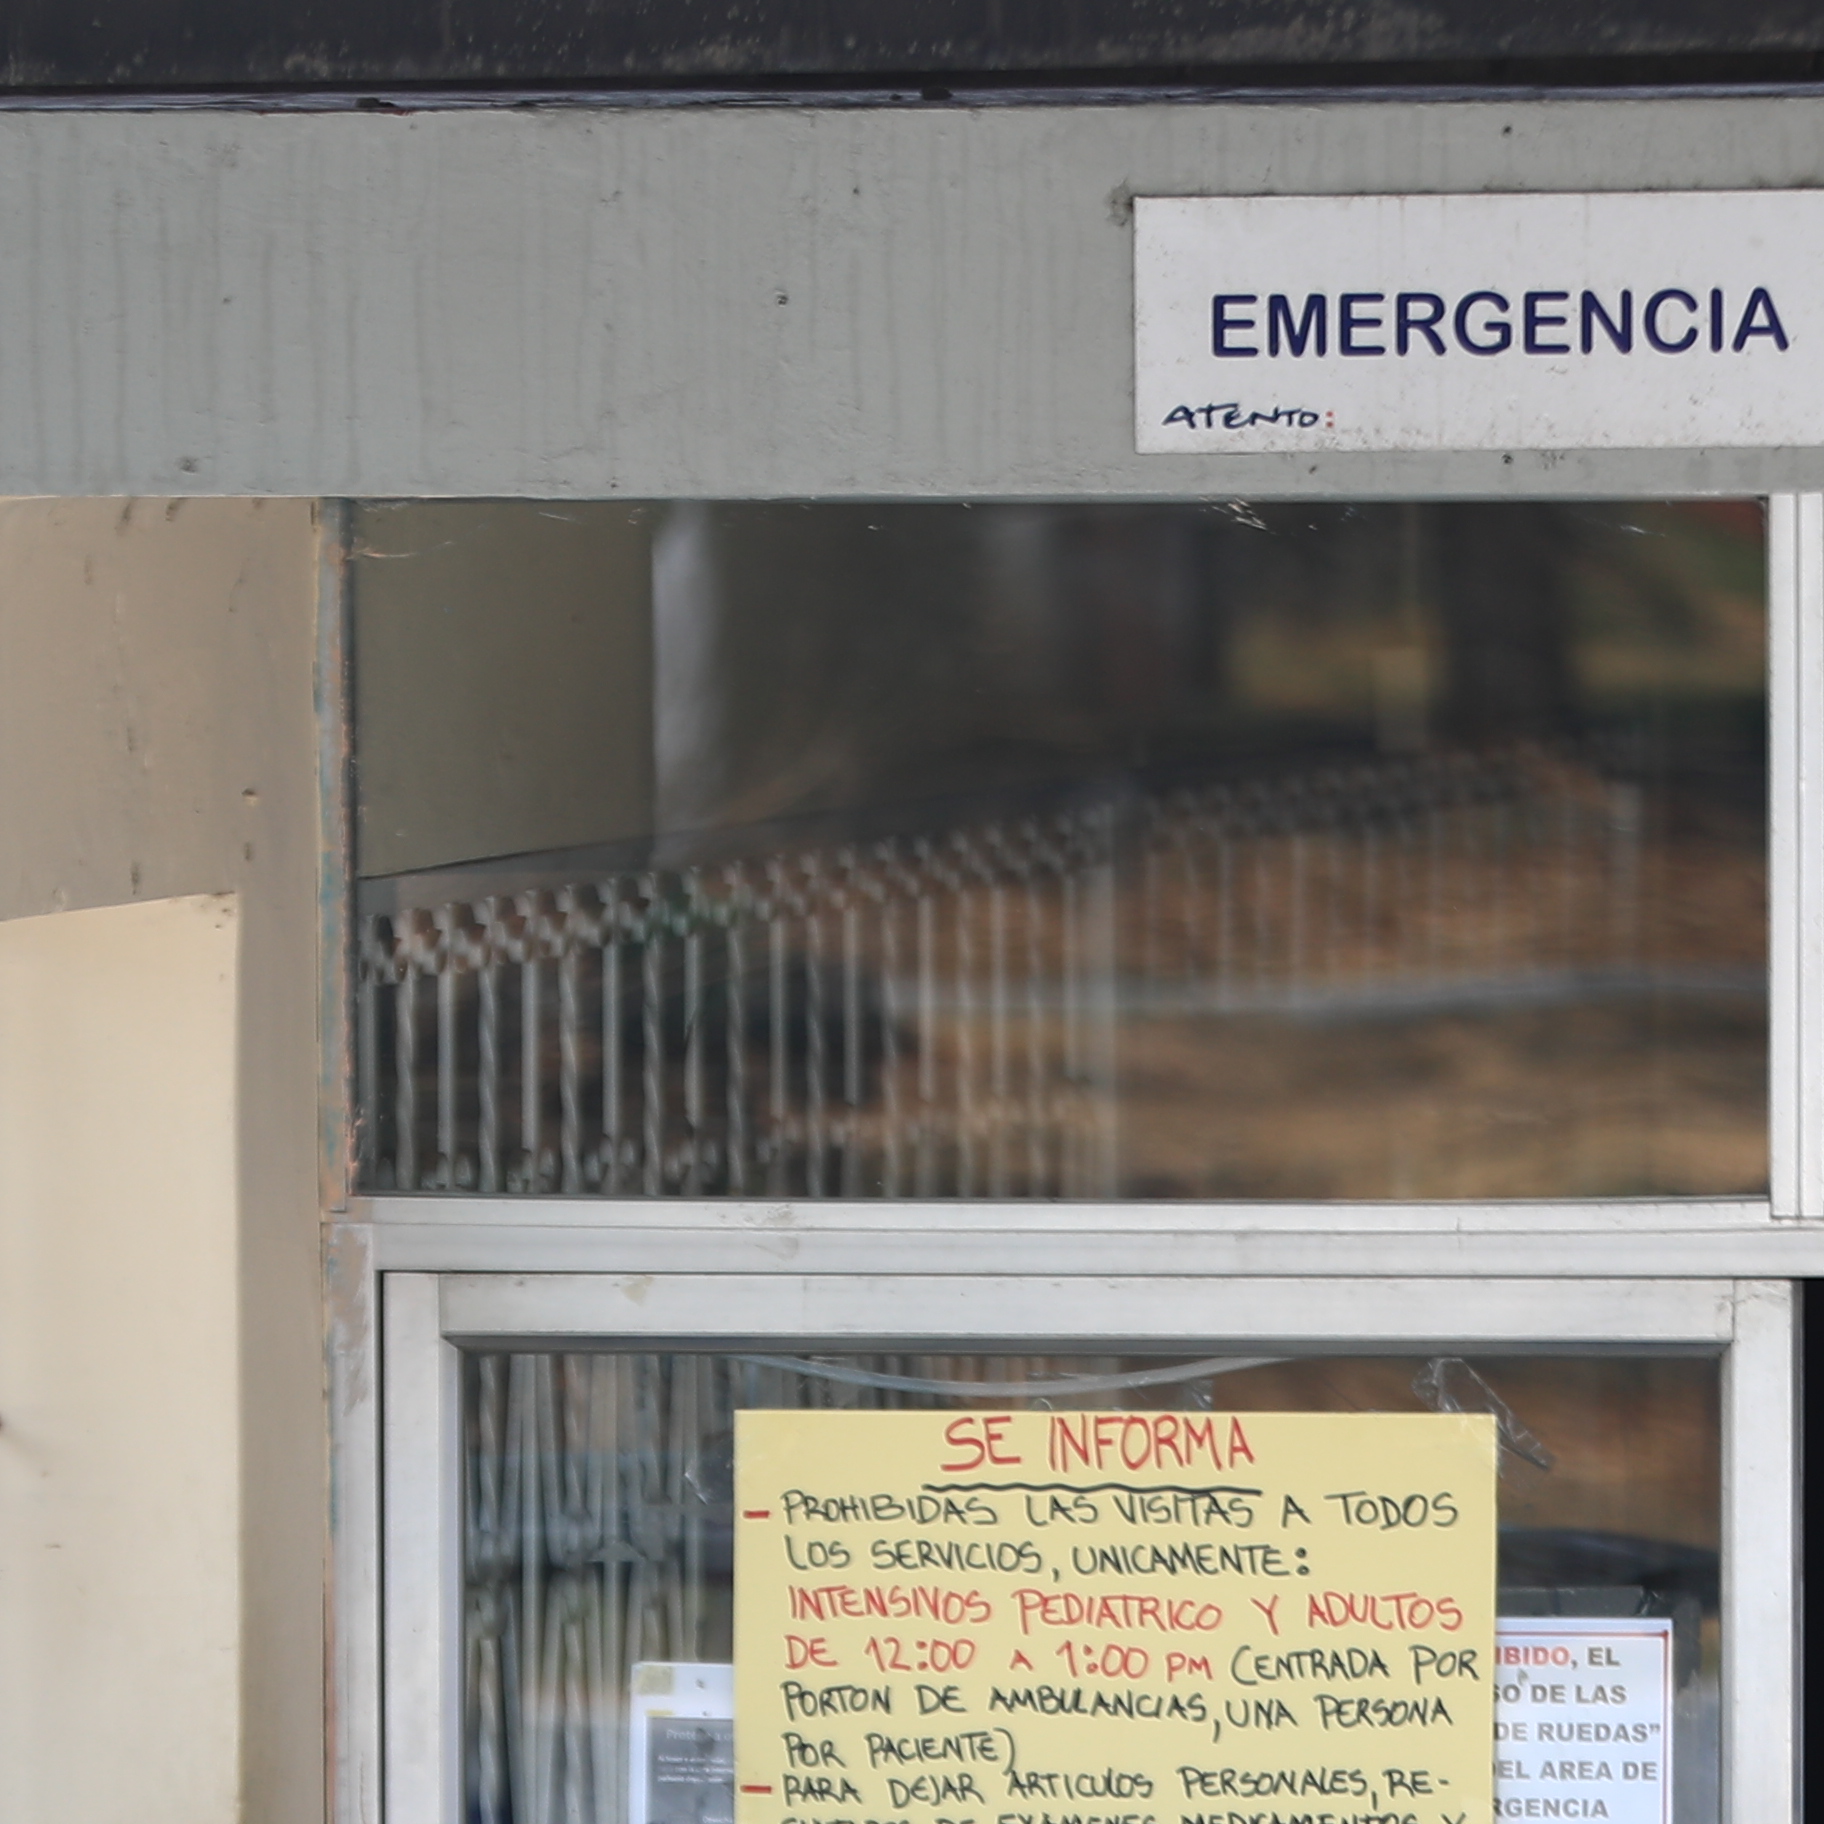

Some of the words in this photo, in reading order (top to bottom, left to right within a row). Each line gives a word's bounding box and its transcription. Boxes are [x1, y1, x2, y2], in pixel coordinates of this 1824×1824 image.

[1211, 287, 1788, 357] EMERGENCIA
[1162, 404, 1335, 429] ATENTO:
[940, 1417, 1023, 1472] SE
[1049, 1417, 1256, 1473] INFORMA
[780, 1489, 999, 1526] PROHIBIDAS
[1025, 1494, 1099, 1528] LAS
[1112, 1489, 1261, 1529] VISITAS
[1281, 1494, 1312, 1529] A
[1323, 1490, 1459, 1531] TODOS
[784, 1534, 852, 1571] LOS
[870, 1539, 1061, 1583] SERVICIOS,
[1072, 1541, 1311, 1577] UNICAMENTE:
[788, 1584, 992, 1625] INTENSIVOS
[1010, 1588, 1223, 1636] PEDIATRICO
[1250, 1594, 1279, 1636] Y
[1308, 1591, 1463, 1632] ADULTOS
[784, 1634, 839, 1670] DE
[864, 1636, 976, 1673] 12:00
[1009, 1649, 1034, 1671] A
[1055, 1639, 1149, 1680] 1:00
[1165, 1651, 1214, 1683] PM
[1408, 1644, 1480, 1686] POR
[1495, 1647, 1579, 1669] IBIDO,
[1587, 1648, 1620, 1666] EL
[779, 1680, 892, 1722] PORTON
[914, 1684, 968, 1716] DE
[1225, 1698, 1299, 1731] UNA
[1314, 1693, 1454, 1731] PERSONA
[1531, 1685, 1566, 1703] DE
[1576, 1685, 1627, 1704] LAS
[781, 1731, 847, 1769] POR
[864, 1727, 1020, 1780] PACIENTE)
[1492, 1761, 1530, 1779] EL
[1539, 1761, 1613, 1781] AREA
[1622, 1762, 1657, 1780] DE
[782, 1773, 863, 1807] PARA
[886, 1772, 986, 1810] DEJAR
[1002, 1762, 1155, 1800] ARTICULOS
[1175, 1765, 1379, 1812] PERSONALES,
